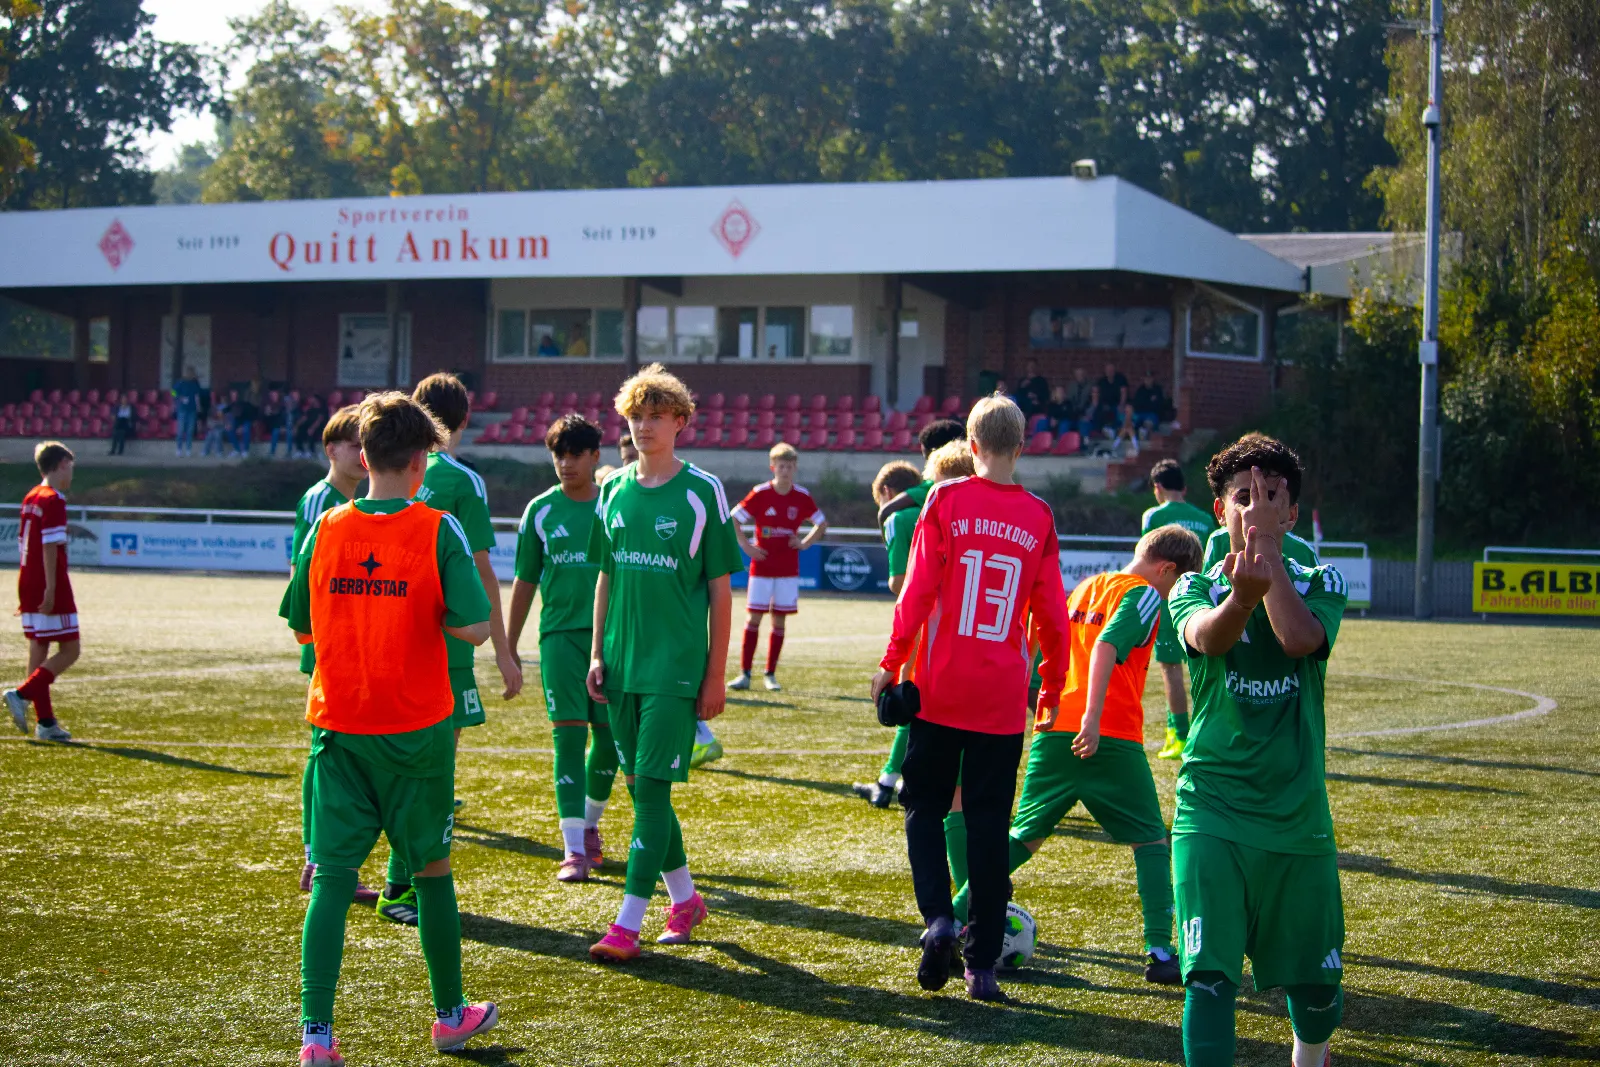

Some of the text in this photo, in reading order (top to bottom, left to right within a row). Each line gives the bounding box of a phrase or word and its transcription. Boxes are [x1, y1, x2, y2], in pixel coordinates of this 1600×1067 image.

[339, 206, 469, 227] Sportverein
[177, 235, 240, 250] Seit 1919
[582, 225, 656, 241] Seit 1919
[269, 228, 549, 272] Quitt Ankum
[951, 518, 1039, 552] GW BROCKDORF
[611, 547, 679, 571] WÖHRMANN
[329, 577, 408, 597] DERBYSTAR
[957, 549, 1022, 643] 13
[1480, 591, 1598, 610] Fahrschule aller
[462, 687, 481, 715] 19
[545, 689, 556, 712] 5
[1183, 916, 1202, 957] 10
